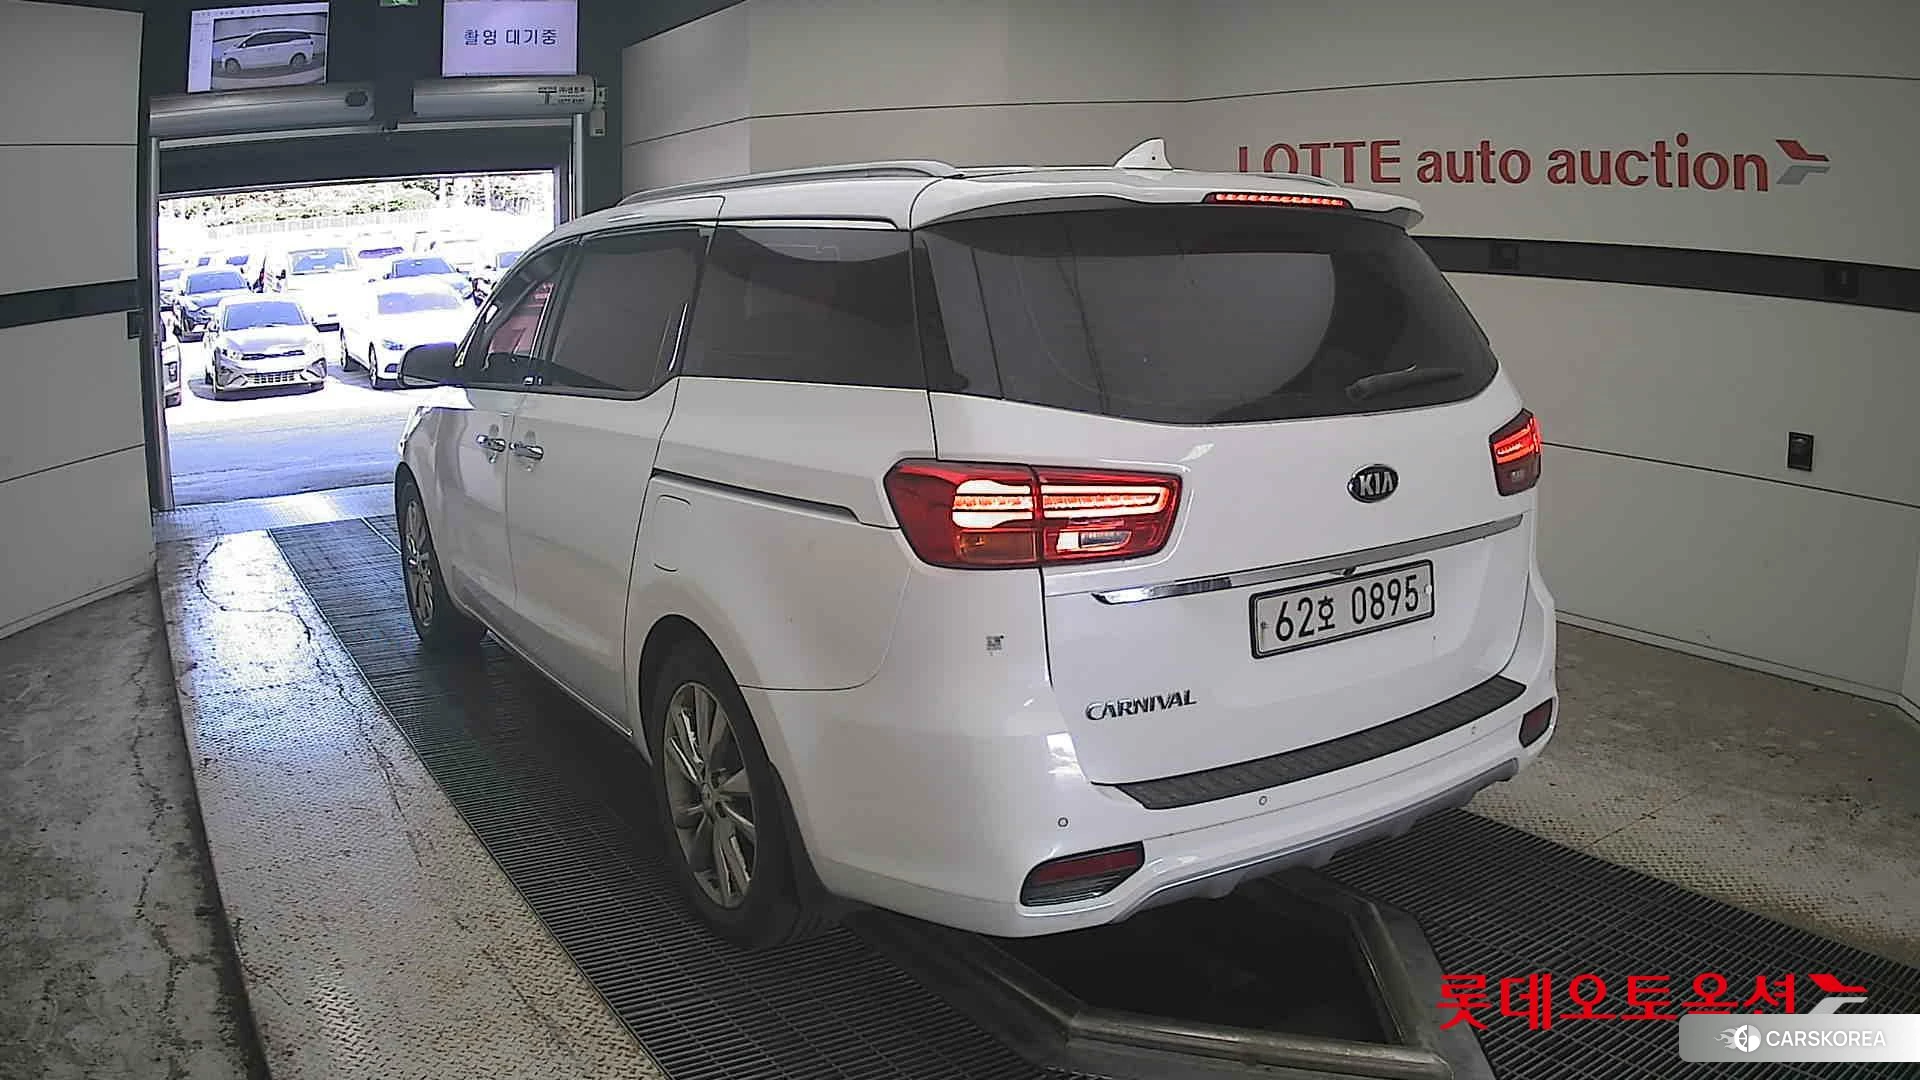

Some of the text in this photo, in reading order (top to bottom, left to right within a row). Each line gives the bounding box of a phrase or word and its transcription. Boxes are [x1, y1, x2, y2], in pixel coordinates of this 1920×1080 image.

[464, 28, 557, 46] 촬영 대기중
[1417, 139, 1533, 185] auto
[1547, 133, 1770, 193] auction
[1275, 574, 1419, 642] 62호 0895
[1086, 688, 1198, 721] CARNIVAL
